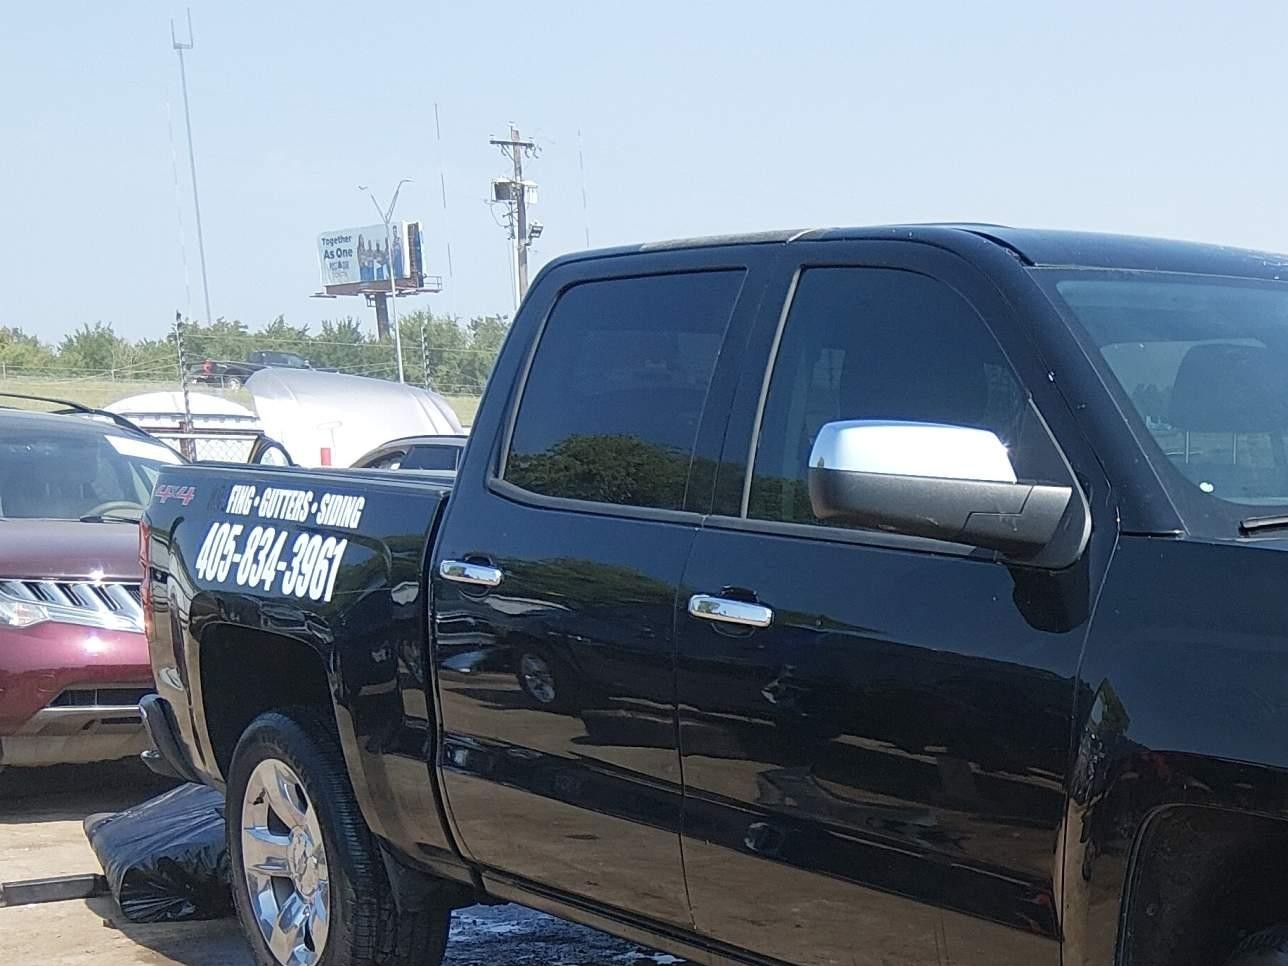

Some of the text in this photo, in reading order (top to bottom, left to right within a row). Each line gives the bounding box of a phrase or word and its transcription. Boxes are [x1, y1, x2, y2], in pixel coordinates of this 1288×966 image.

[321, 235, 352, 246] Together
[324, 248, 352, 259] As One
[258, 488, 314, 522] GUTTERS
[316, 493, 366, 529] SIDING
[195, 522, 348, 602] 405-834-3961
